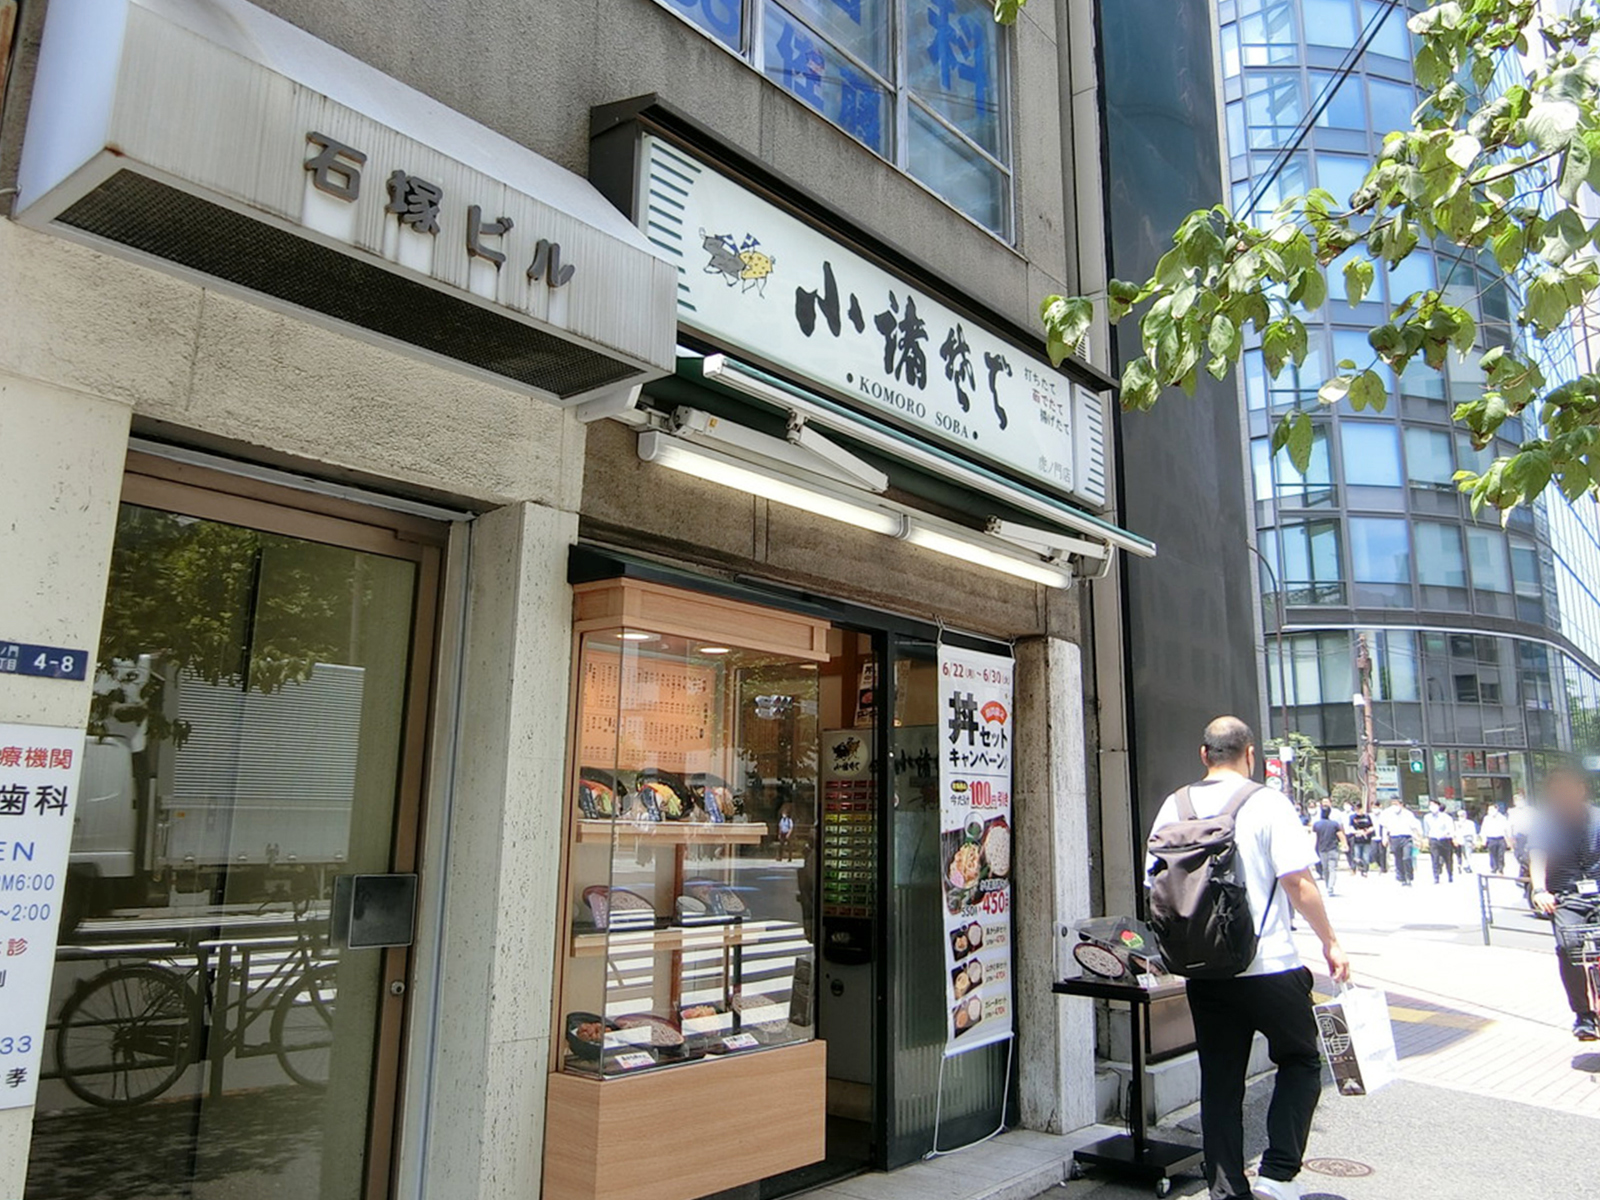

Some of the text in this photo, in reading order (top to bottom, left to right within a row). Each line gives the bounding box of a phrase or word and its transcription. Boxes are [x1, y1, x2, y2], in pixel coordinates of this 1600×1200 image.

[303, 130, 575, 288] 石塚ビル
[1024, 366, 1057, 396] 打ちたて
[858, 374, 969, 440] KOMORO SOBA
[33, 652, 75, 673] 4-8
[0, 746, 73, 770] 療機関
[0, 783, 68, 816] 歯科
[0, 873, 55, 892] M6:00
[0, 1035, 32, 1056] 33
